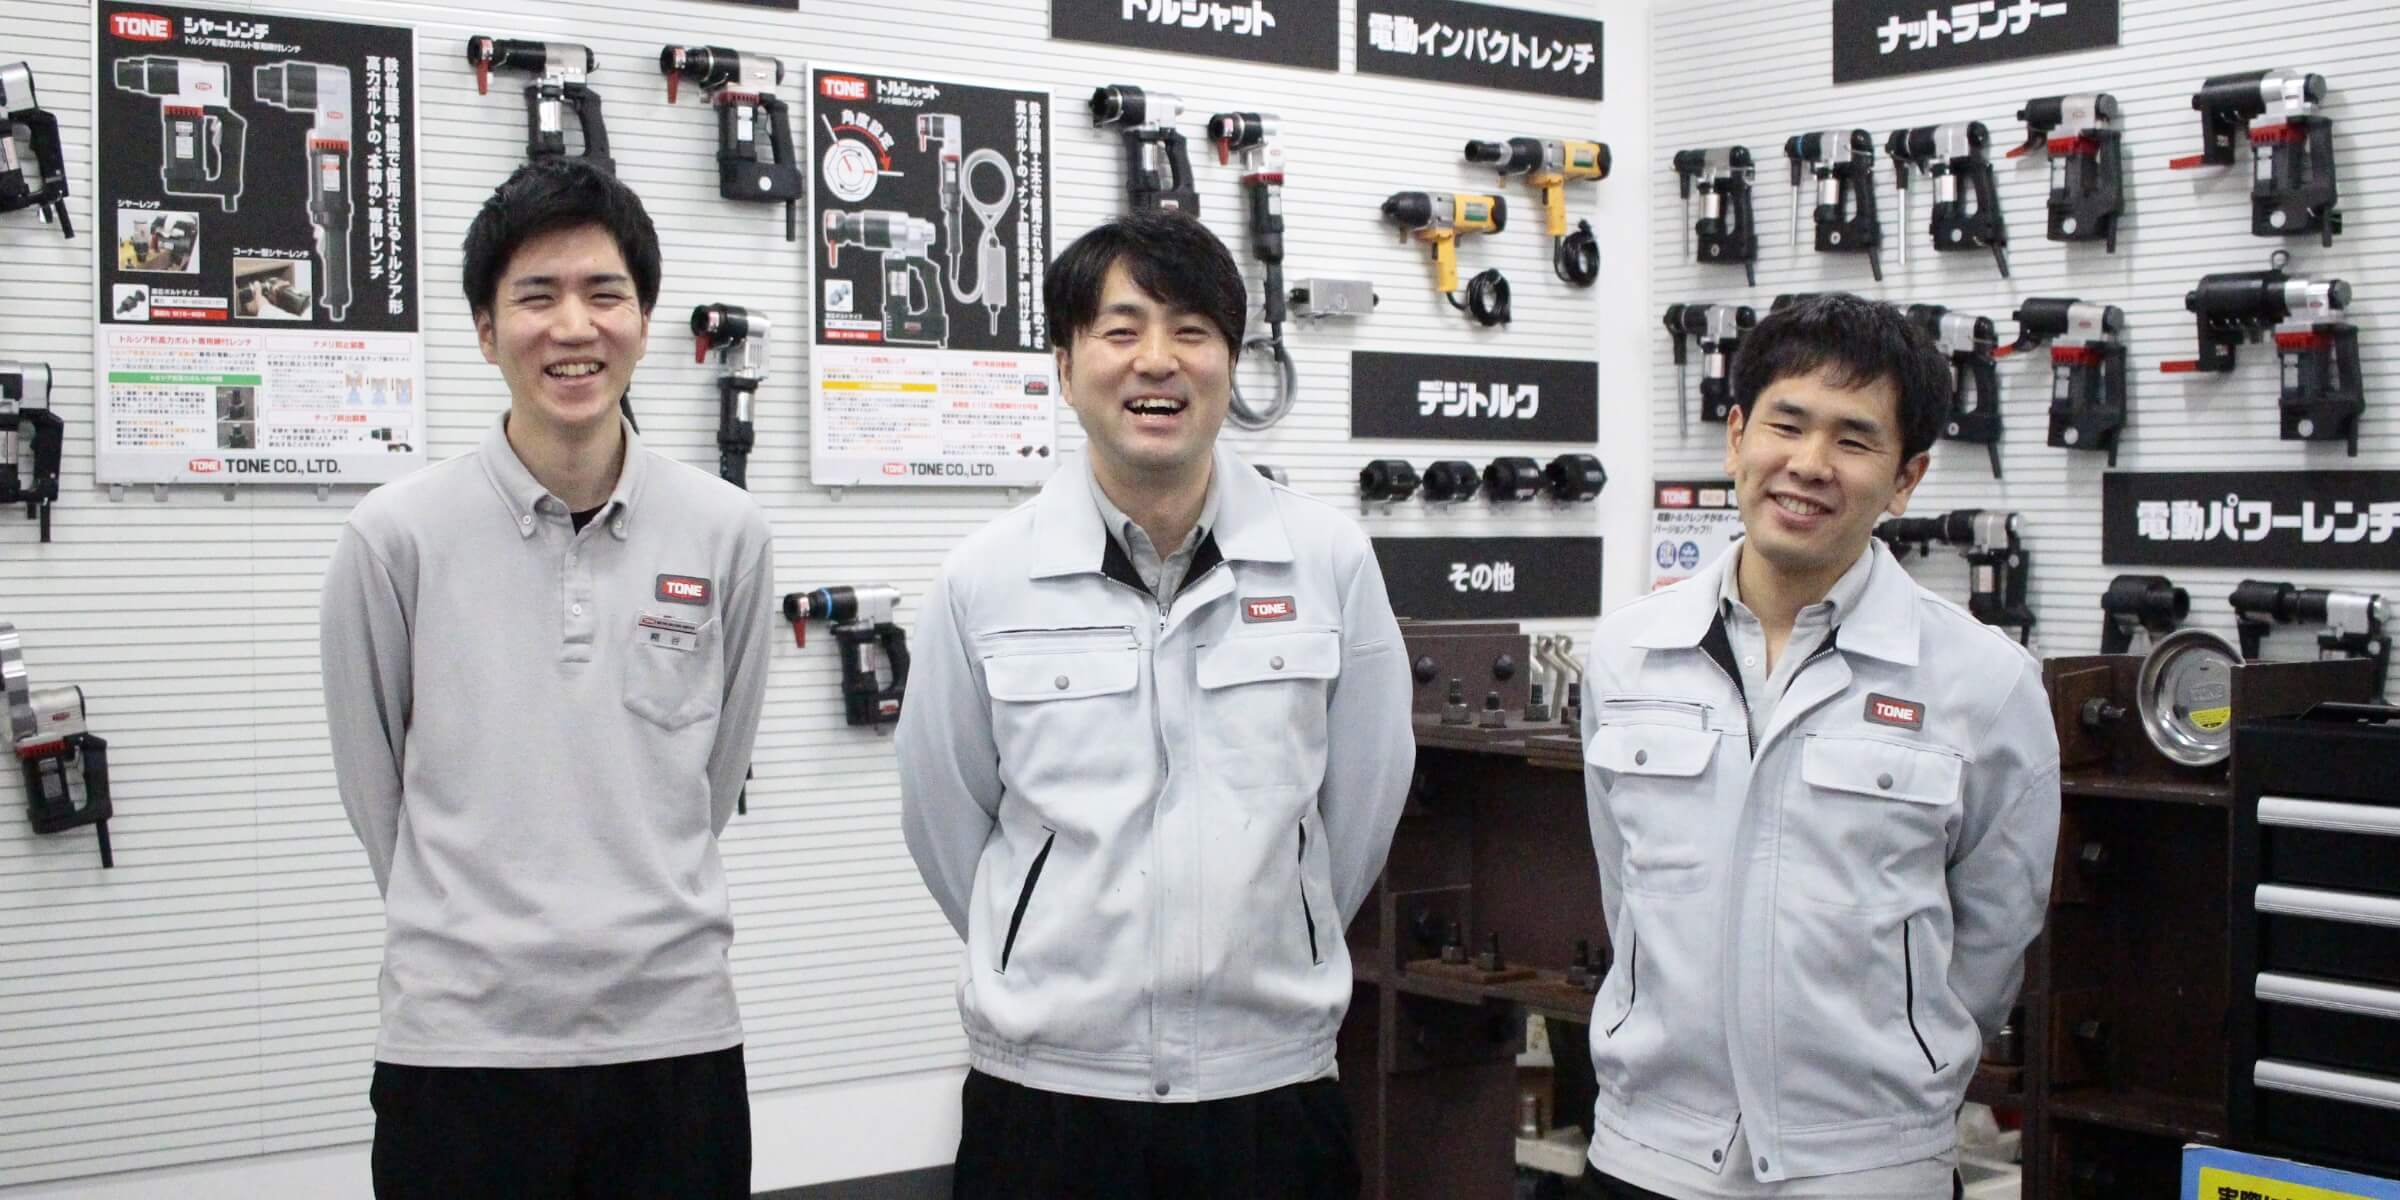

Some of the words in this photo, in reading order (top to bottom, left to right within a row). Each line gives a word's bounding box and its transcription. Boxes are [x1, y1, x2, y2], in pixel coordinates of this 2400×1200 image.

[115, 16, 169, 38] TONE
[1122, 0, 1276, 36] トルシャット
[1876, 0, 2067, 54] ナットランナー
[1368, 12, 1595, 75] 電動インパクトレンチ
[824, 79, 865, 98] TONE
[876, 79, 941, 100] トルシャット
[1418, 380, 1539, 419] デジトルク
[225, 458, 271, 473] TONE
[274, 459, 304, 476] CO.,
[307, 459, 341, 474] LTD.
[910, 463, 943, 476] TONE
[946, 464, 969, 478] CO.,
[971, 464, 998, 477] LTD.
[2137, 492, 2400, 543] 電動パワーレンチ
[1448, 561, 1515, 592] その他
[666, 581, 703, 597] TONE
[1250, 602, 1288, 616] TONE
[1876, 702, 1914, 721] TONE
